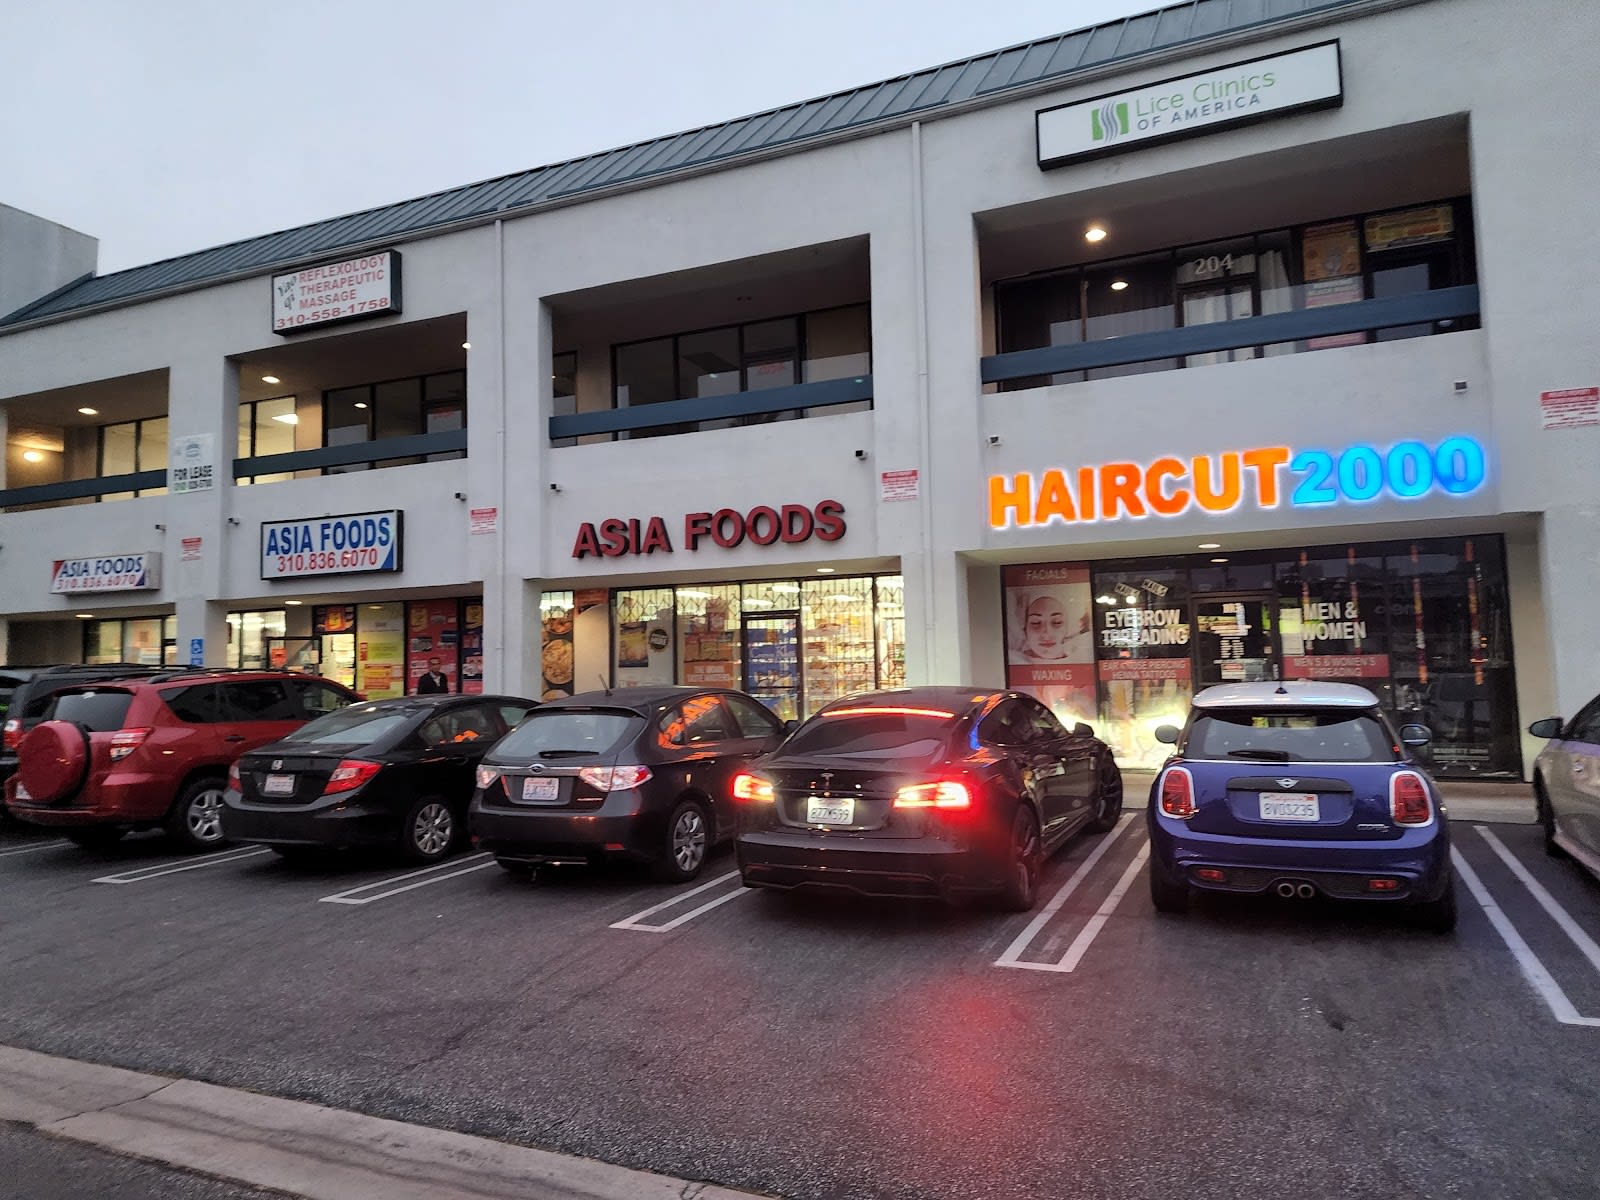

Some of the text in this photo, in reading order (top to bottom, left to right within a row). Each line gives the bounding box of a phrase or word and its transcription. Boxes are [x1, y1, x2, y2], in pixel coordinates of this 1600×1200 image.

[1136, 71, 1275, 117] Lice Clinics
[1137, 93, 1261, 131] OF AMERICA
[298, 254, 387, 283] REFLEXOLOGY
[1193, 253, 1234, 275] 204
[299, 269, 385, 297] THERAPEUTIC
[298, 289, 357, 310] MASSAGE
[276, 297, 389, 328] 310-558-1758
[173, 465, 213, 481] FOR LEASE
[266, 517, 391, 556] ASIA FOODS
[572, 499, 847, 559] ASIA FOODS
[60, 556, 143, 579] ASIA FOODS
[277, 548, 378, 573] 310.836.6070
[1026, 568, 1068, 580] FACIALS
[1105, 609, 1180, 628] EYEBROW
[1303, 602, 1341, 620] MEN
[1344, 601, 1359, 619] &
[1101, 628, 1189, 646] THREADING
[1300, 621, 1367, 640] WOMEN
[1032, 669, 1072, 681] WAXING
